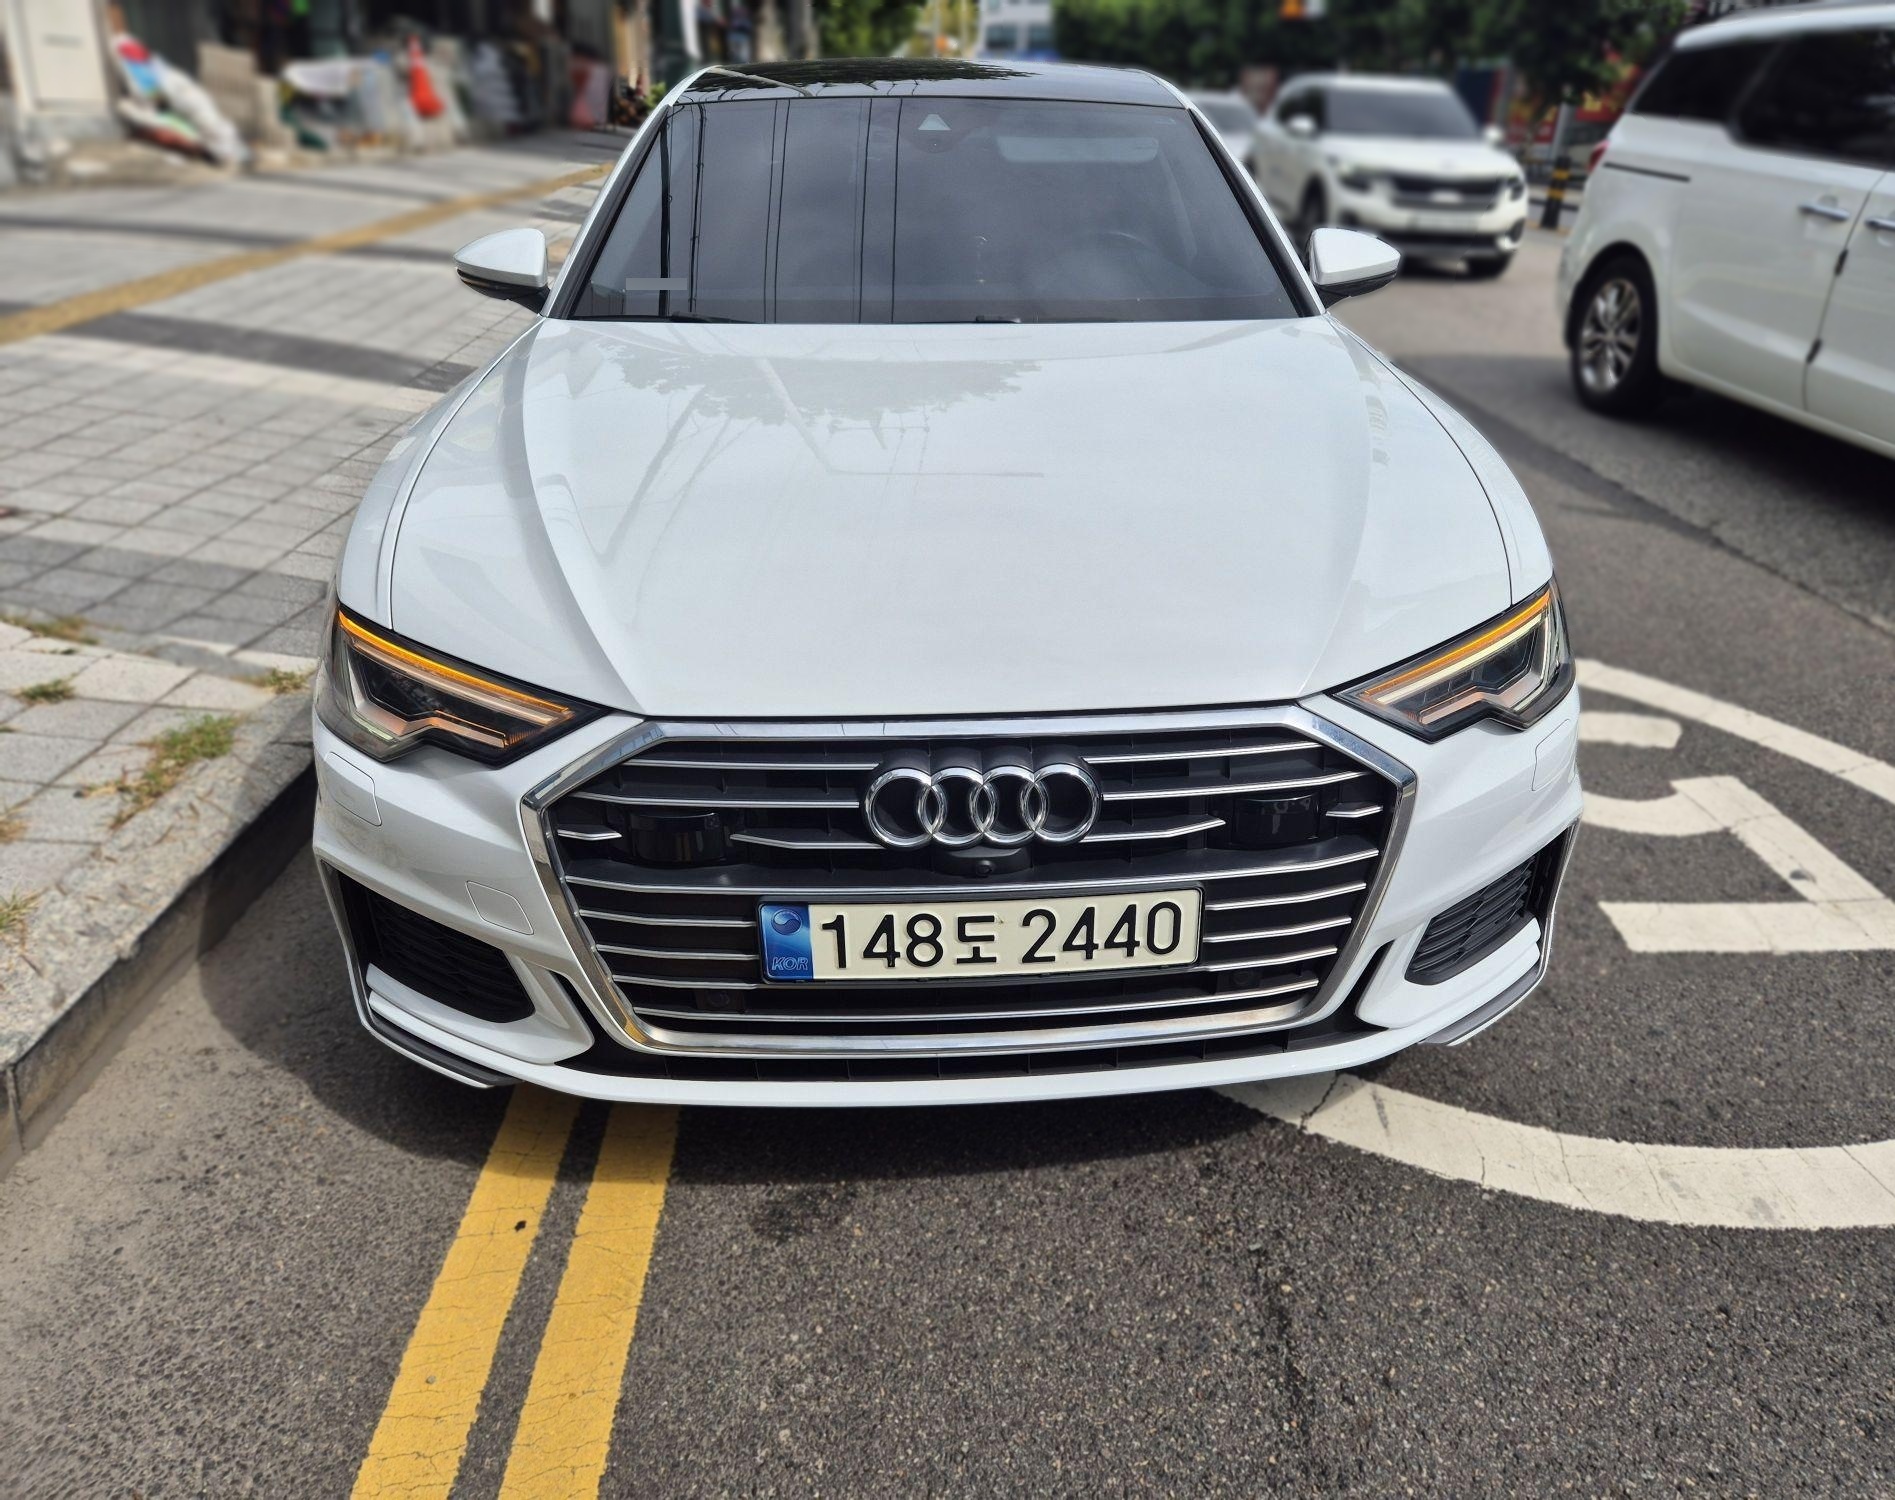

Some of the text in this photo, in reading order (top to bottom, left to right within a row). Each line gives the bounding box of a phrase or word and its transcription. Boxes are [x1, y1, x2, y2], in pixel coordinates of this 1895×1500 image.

[821, 901, 1182, 969] 148도 2440
[771, 956, 809, 971] KOR
